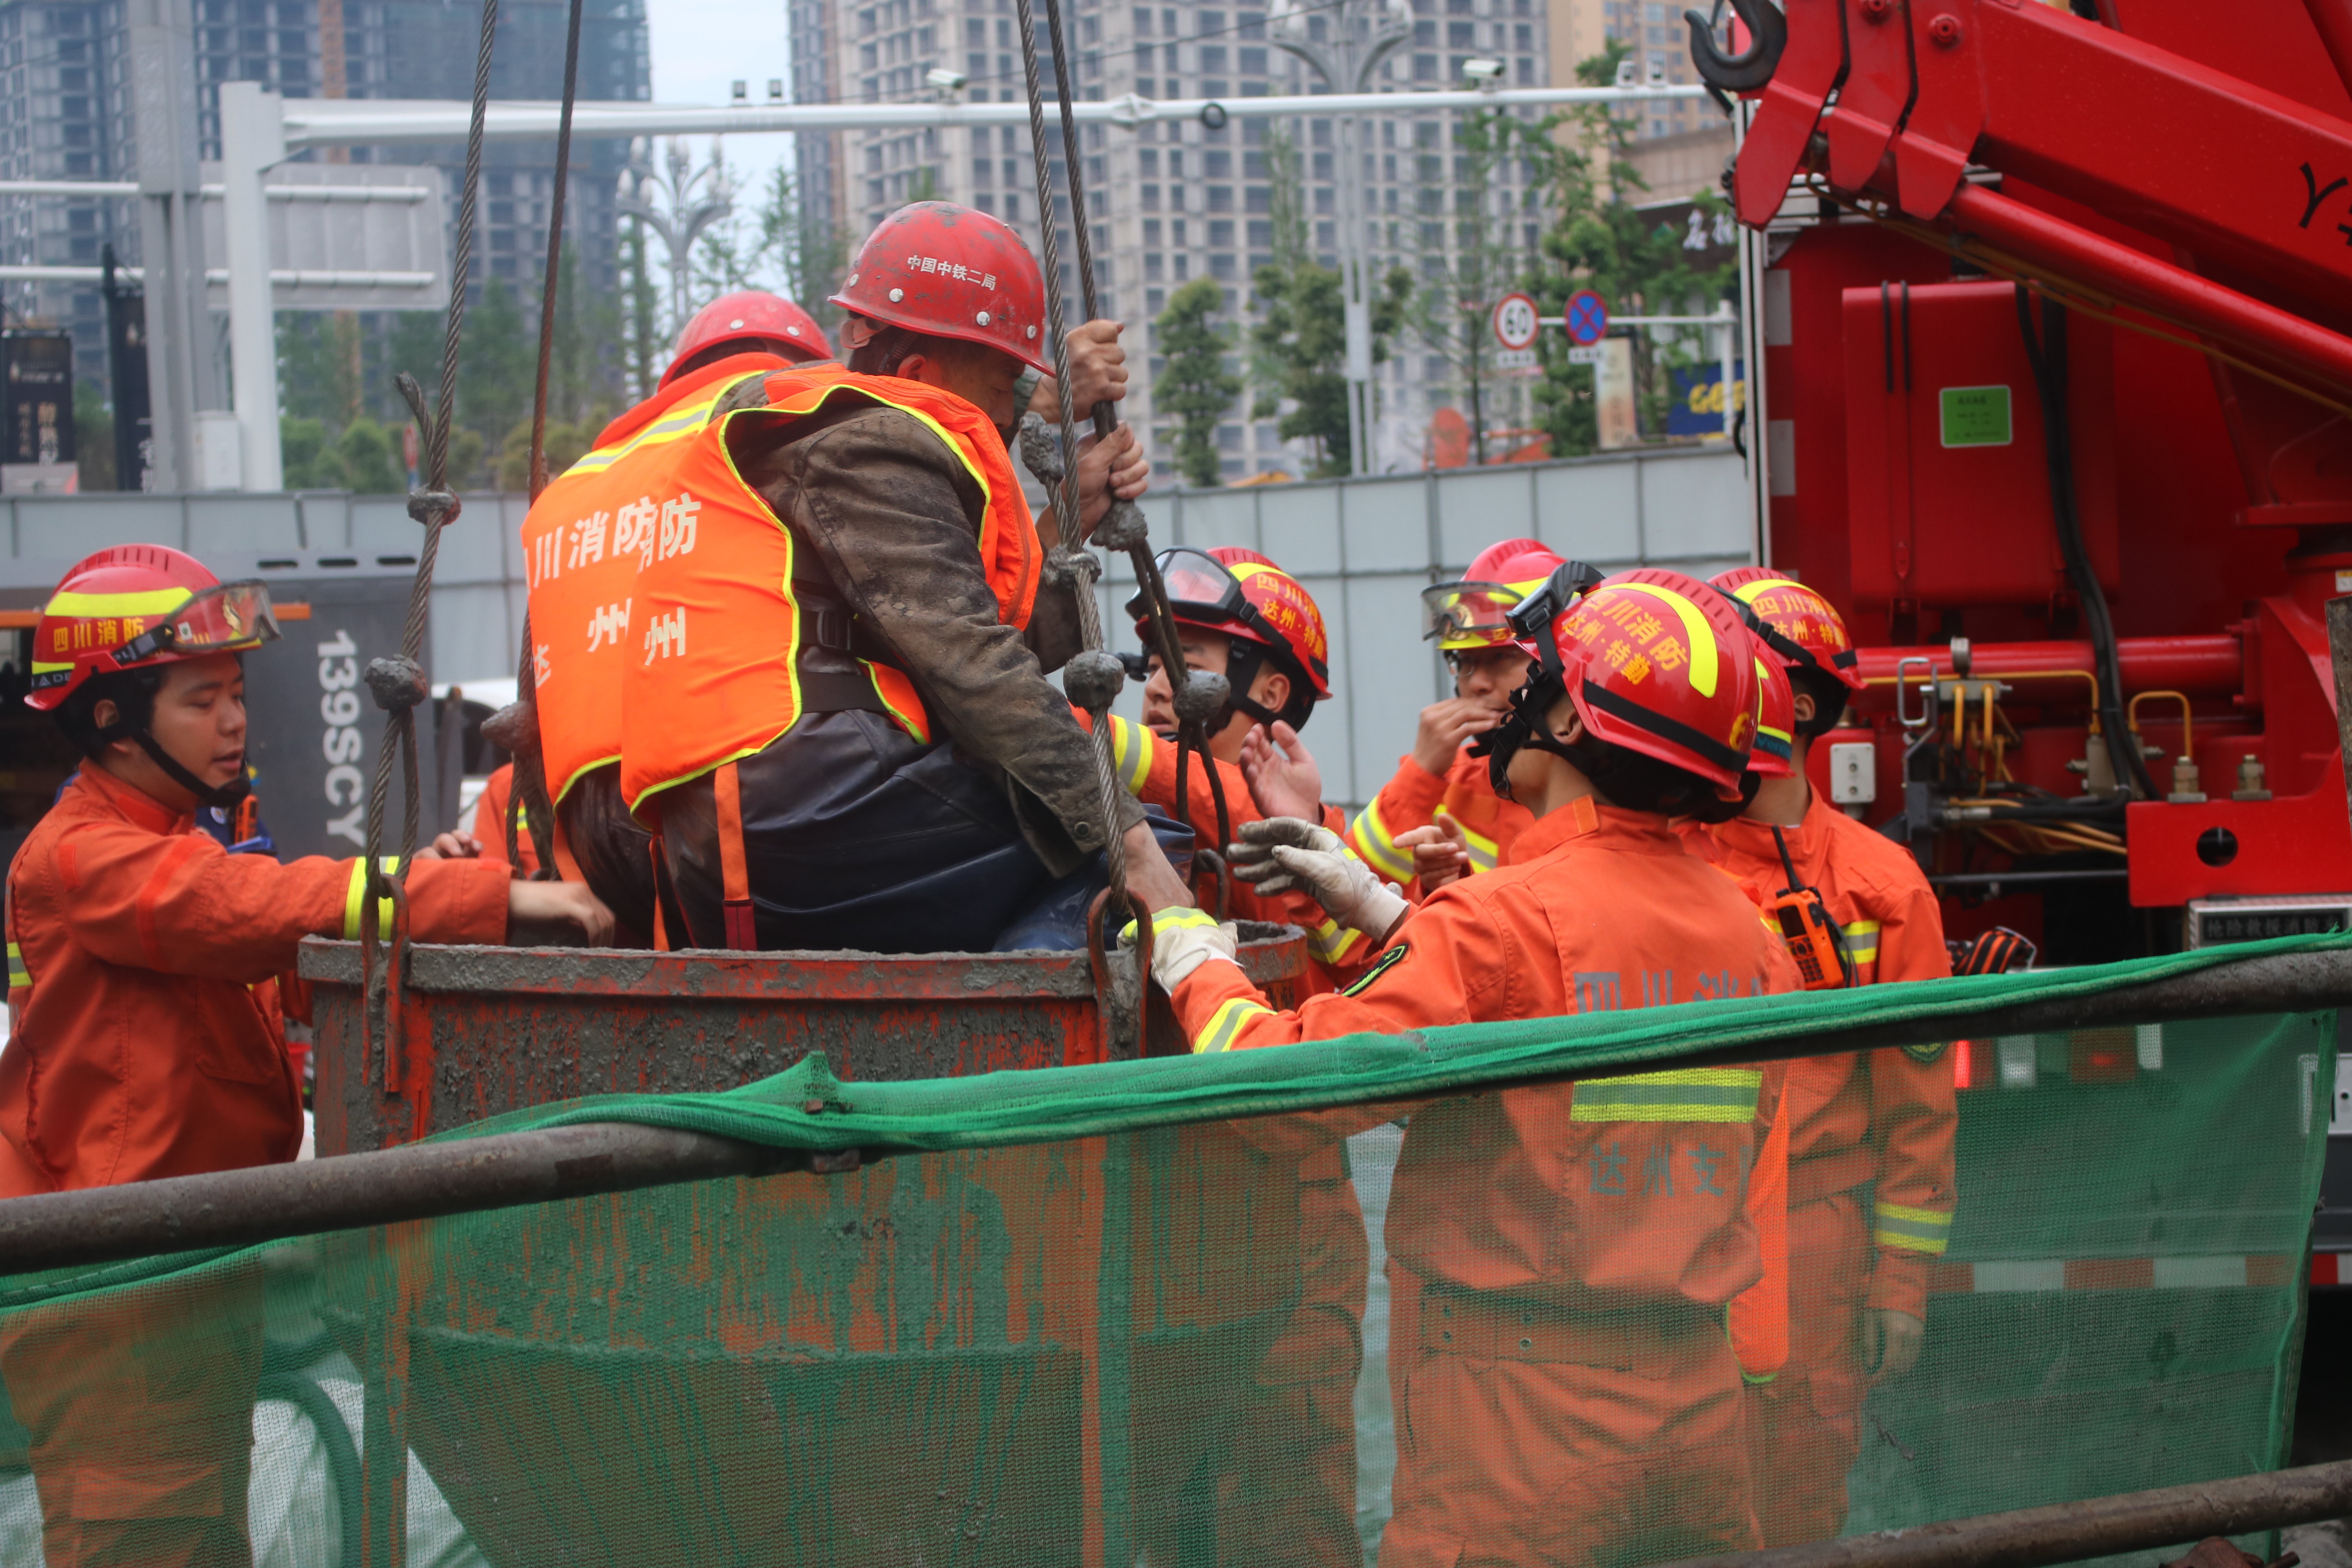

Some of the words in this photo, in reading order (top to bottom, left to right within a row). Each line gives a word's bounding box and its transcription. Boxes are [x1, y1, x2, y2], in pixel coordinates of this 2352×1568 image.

[907, 255, 996, 291] 中国中铁二局
[1505, 305, 1528, 335] 60
[524, 495, 656, 595] 川消防
[644, 606, 686, 666] 州
[1581, 591, 1688, 671] 四川消防
[317, 629, 366, 847] 139SCY
[1573, 969, 1762, 1014] 四川消
